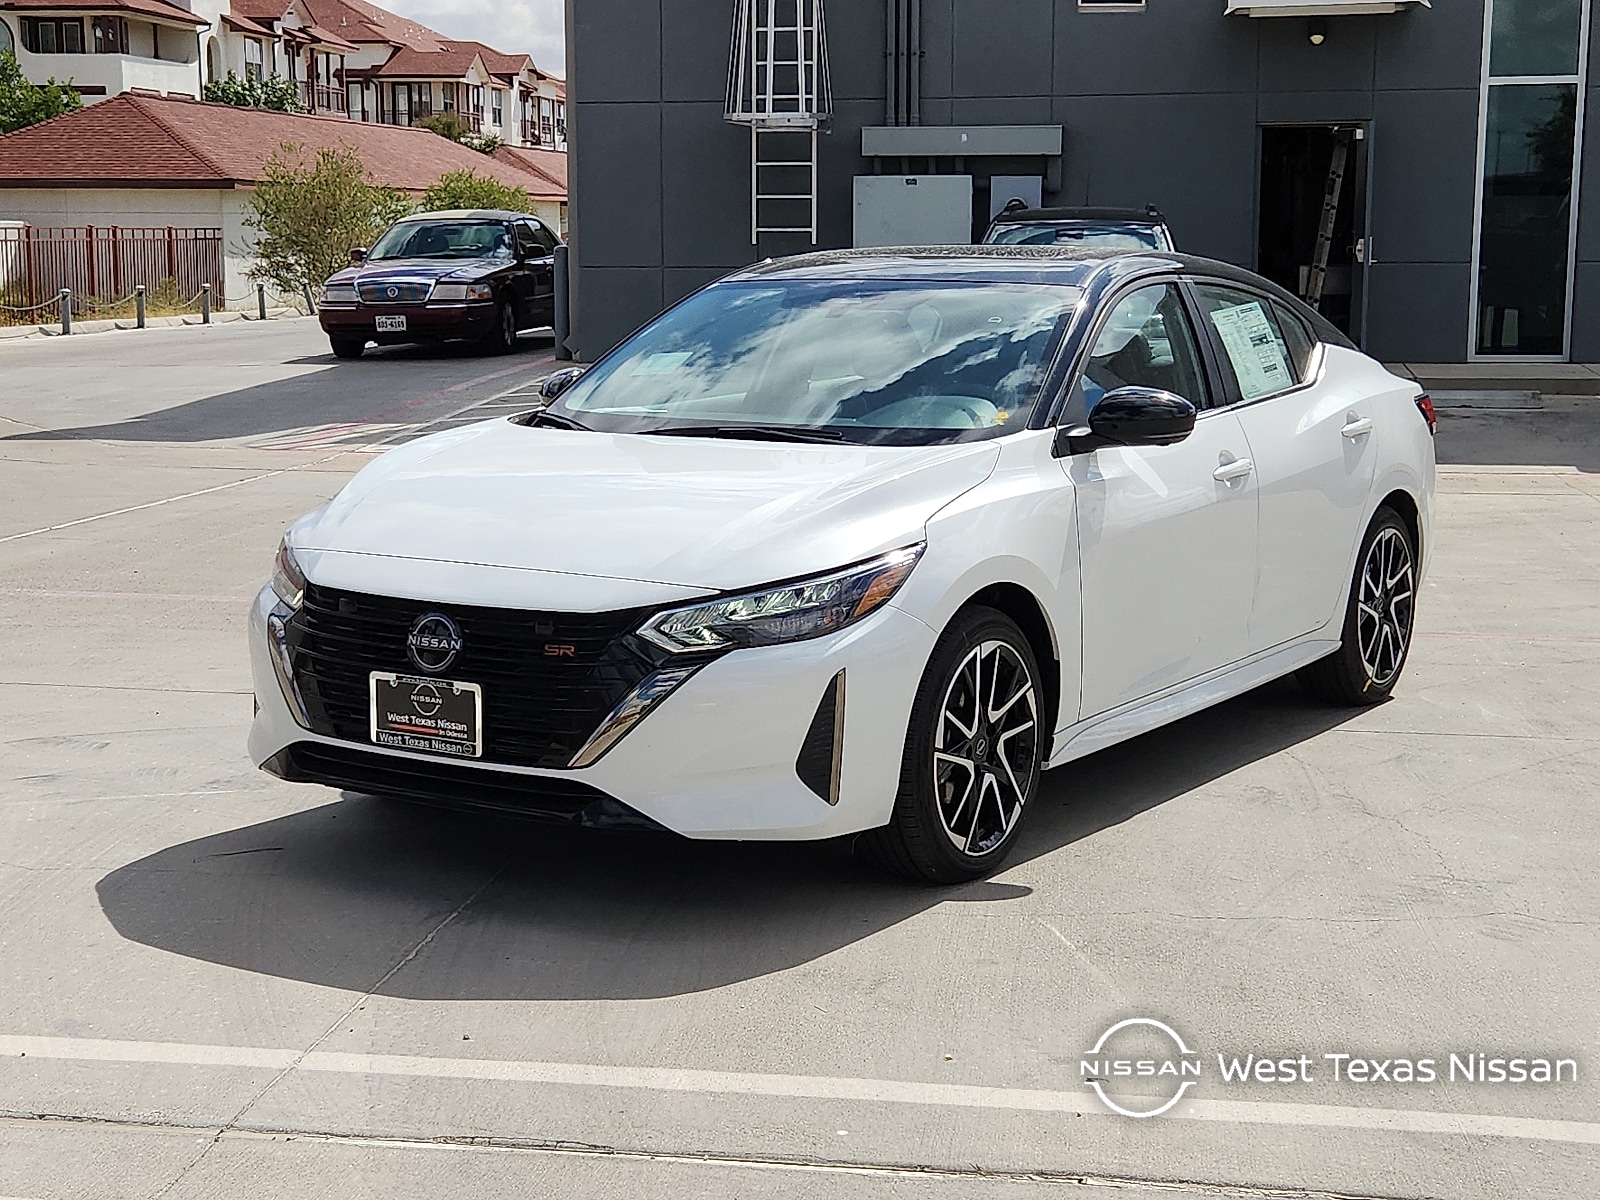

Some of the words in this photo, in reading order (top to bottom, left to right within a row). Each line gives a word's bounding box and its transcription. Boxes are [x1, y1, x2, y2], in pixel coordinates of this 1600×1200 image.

[408, 635, 461, 650] NISSAN
[544, 644, 575, 657] SR
[411, 694, 442, 704] NISSAN
[387, 712, 409, 723] West
[410, 715, 436, 727] Texas
[437, 719, 467, 731] Nissan
[379, 732, 402, 745] West
[403, 736, 430, 748] Texas
[431, 740, 462, 753] Nissan
